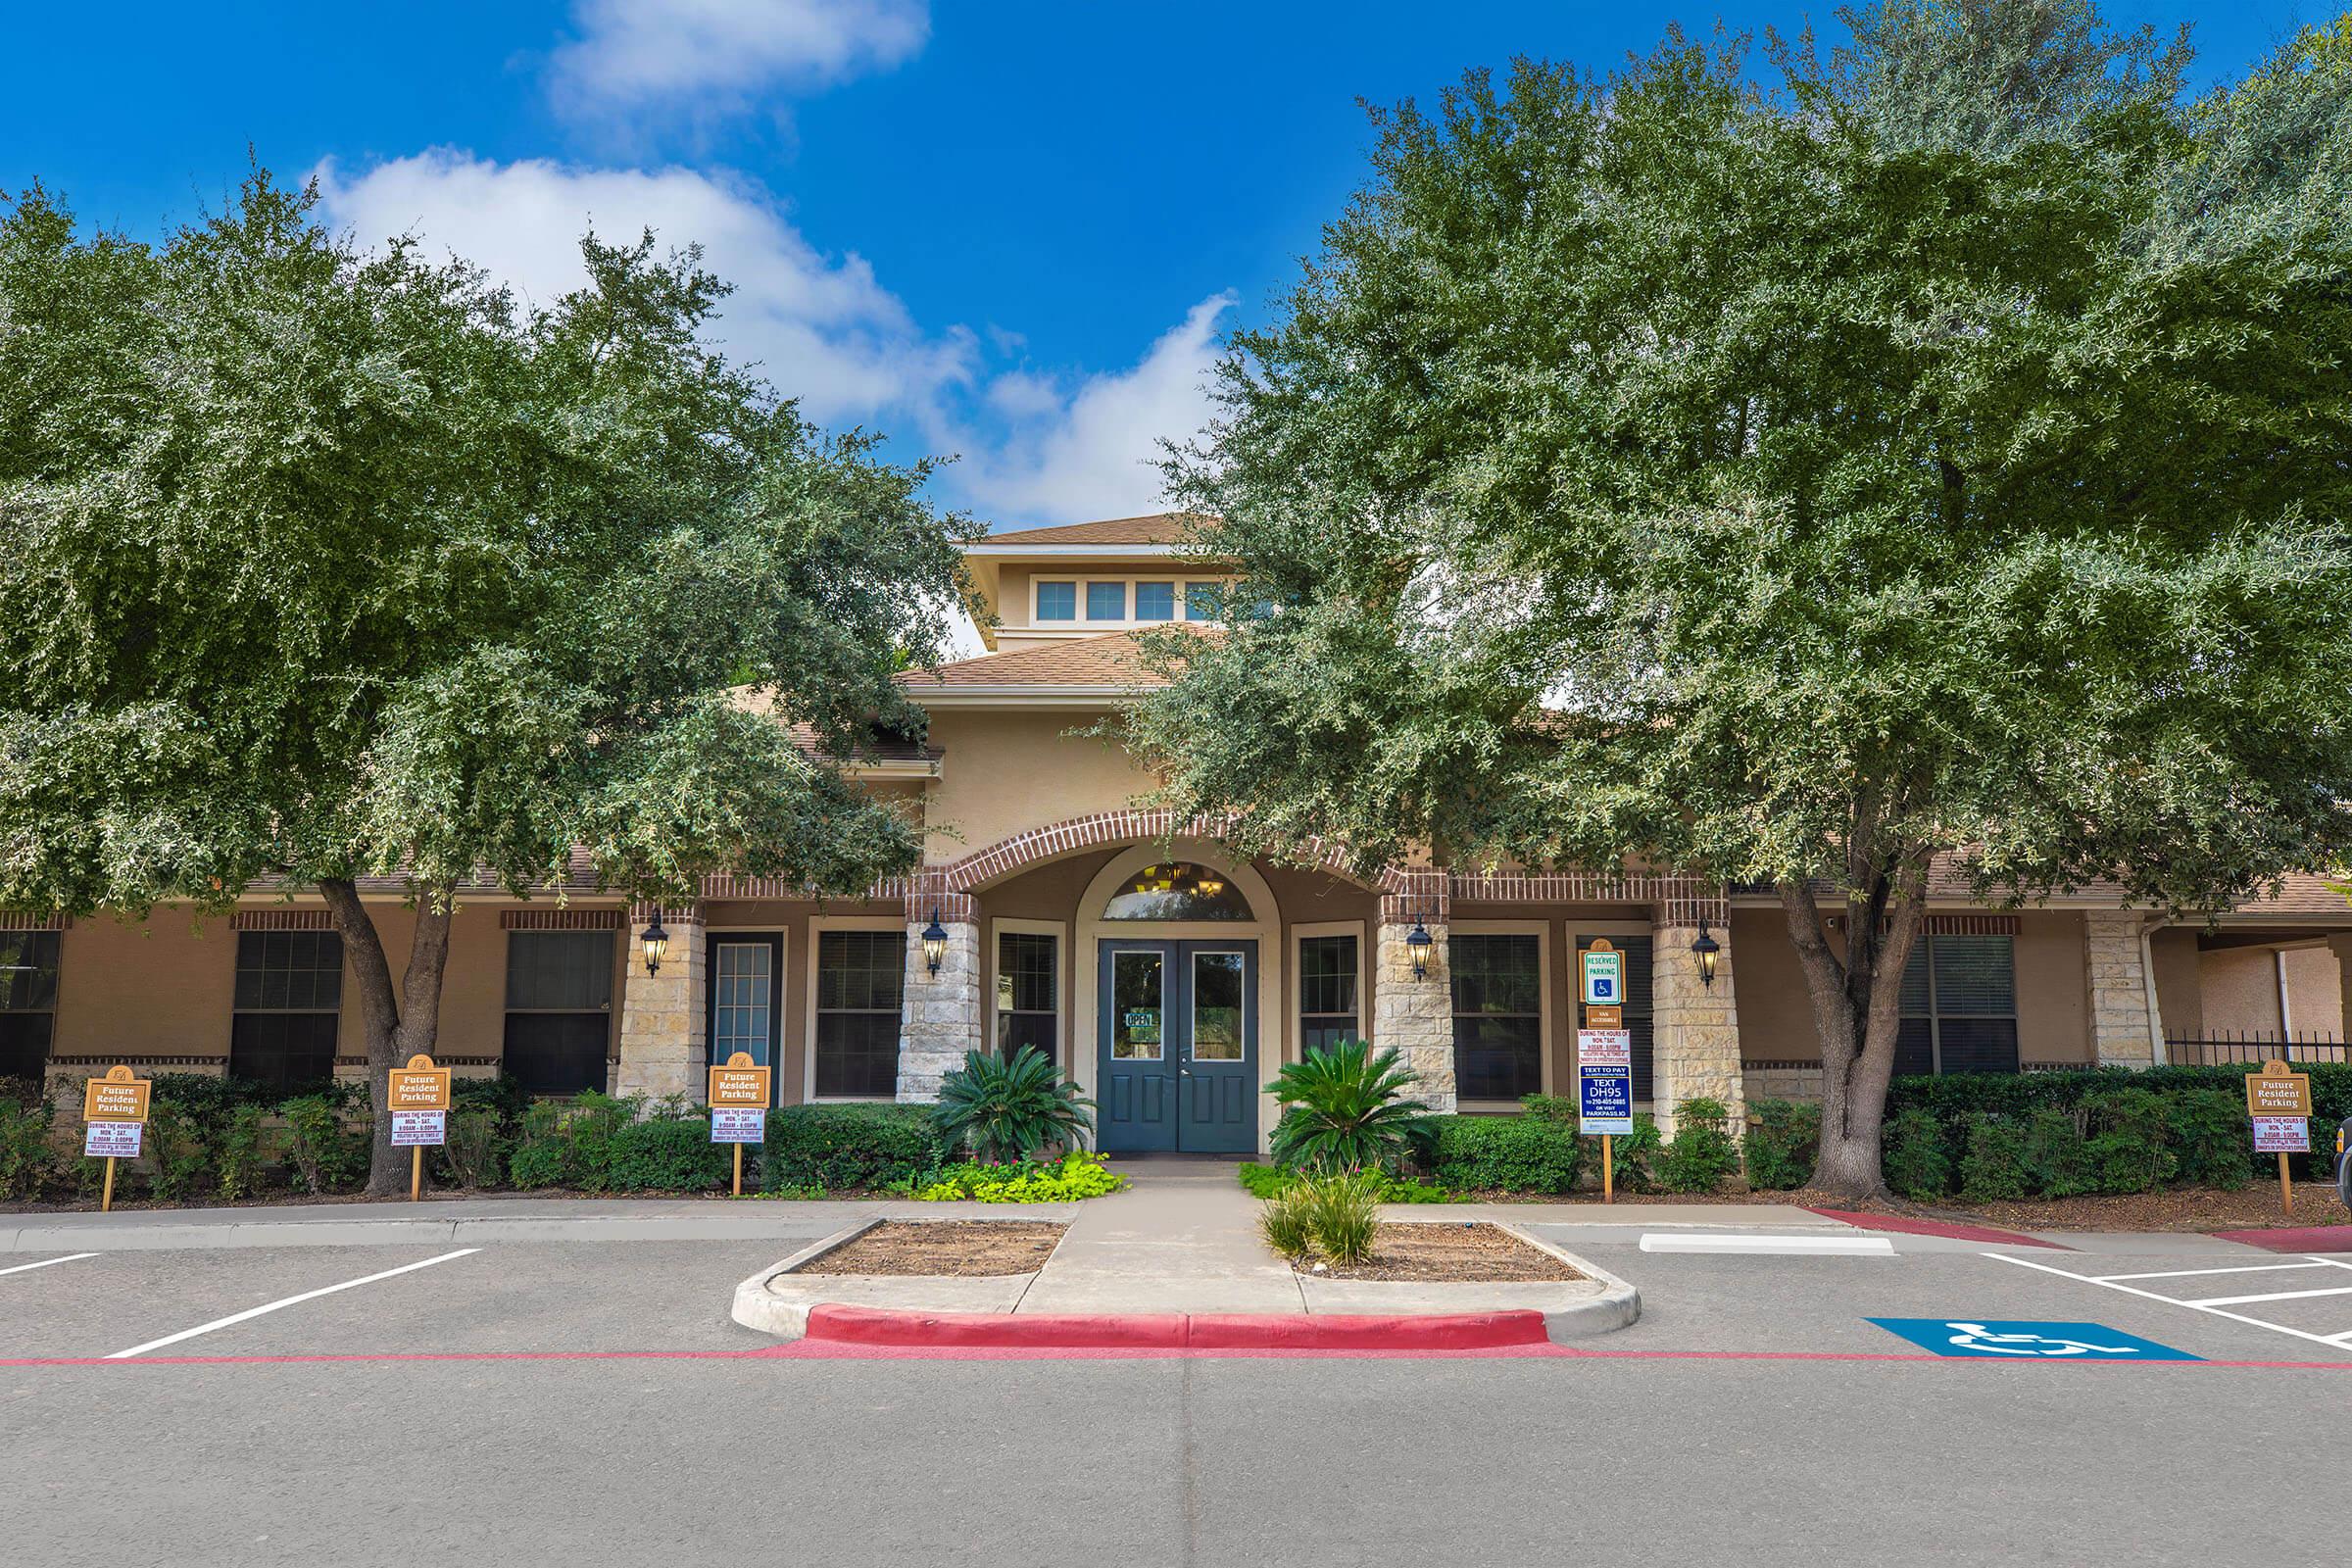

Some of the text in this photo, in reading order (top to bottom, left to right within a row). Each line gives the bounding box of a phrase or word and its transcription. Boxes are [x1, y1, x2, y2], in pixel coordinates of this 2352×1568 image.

[1128, 1014, 1150, 1025] OPEN
[721, 1091, 757, 1100] Parking
[1590, 1087, 1622, 1097] DH95
[401, 1094, 436, 1102] Parking
[2261, 1099, 2298, 1108] Parking
[98, 1104, 135, 1114] Parking
